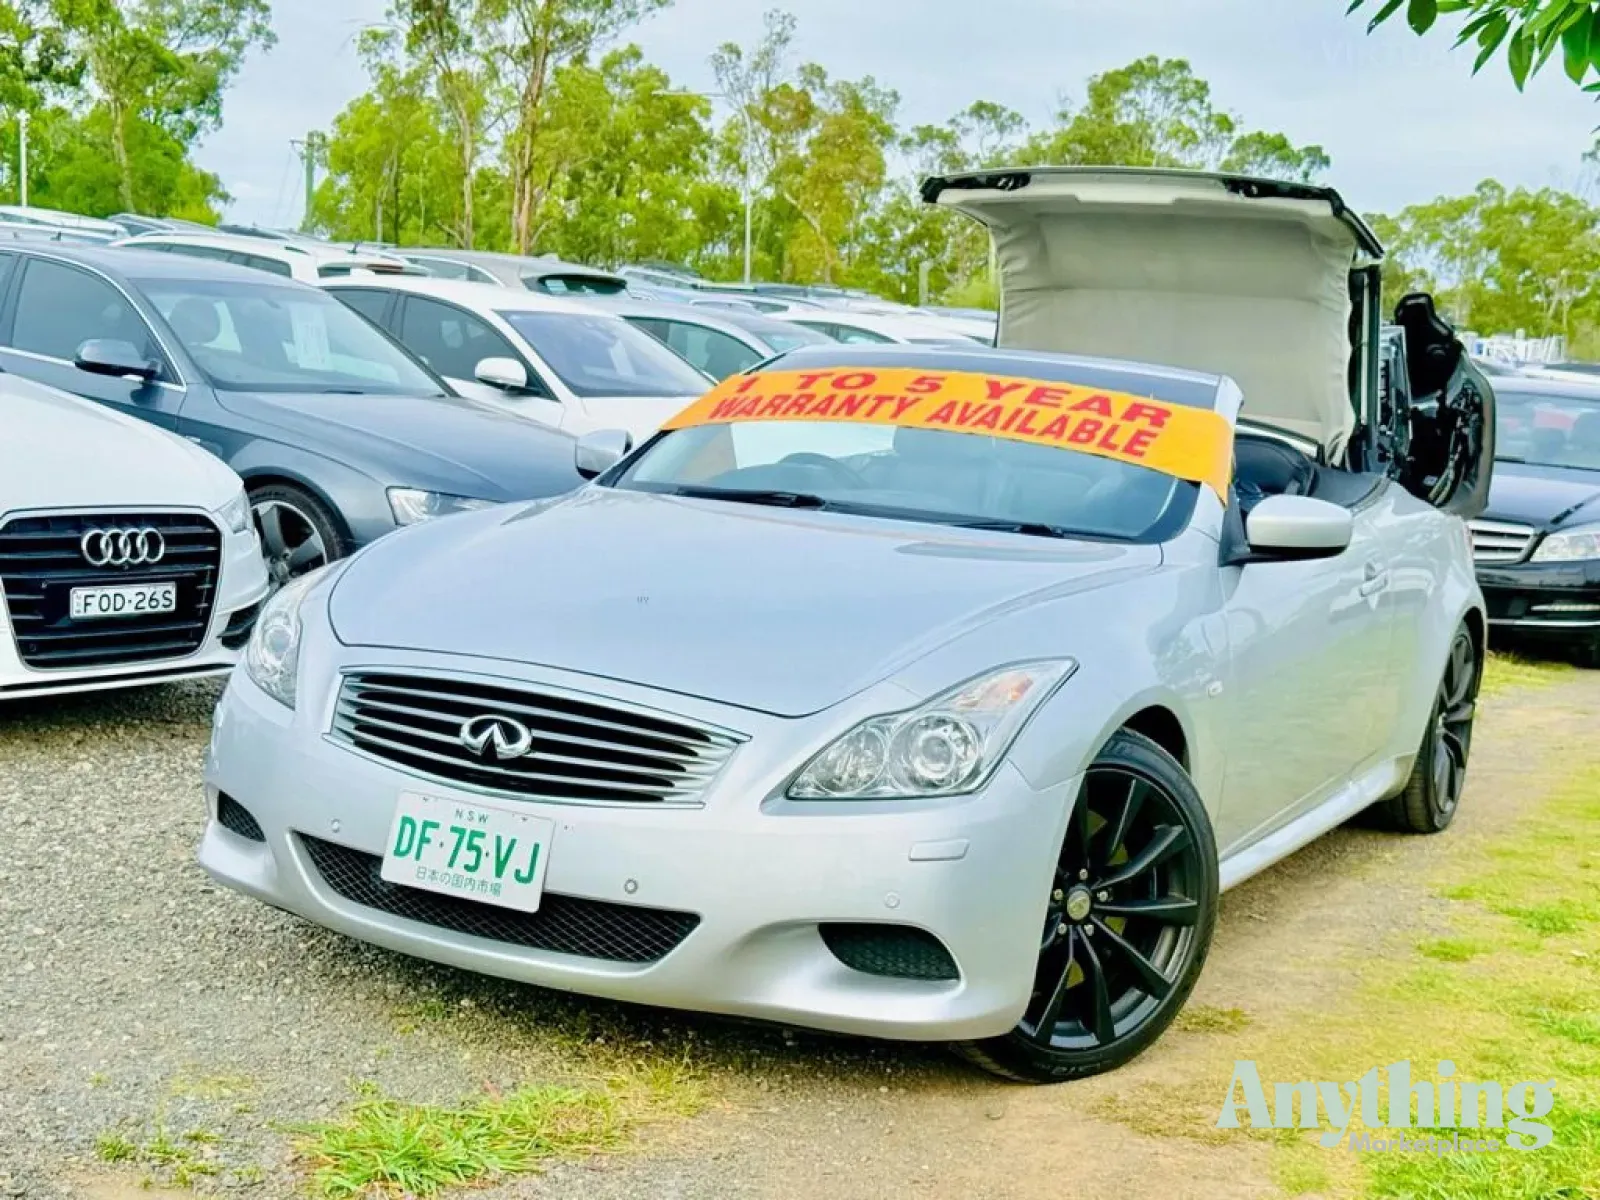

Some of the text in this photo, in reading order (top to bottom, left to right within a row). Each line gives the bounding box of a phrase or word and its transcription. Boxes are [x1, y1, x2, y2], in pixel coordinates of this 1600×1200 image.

[737, 373, 1172, 428] 1 TO 5 YEAR
[708, 394, 1159, 457] WARRANTY AVAILABLE
[455, 808, 490, 824] NSW
[415, 866, 503, 897] 日本の国内市場
